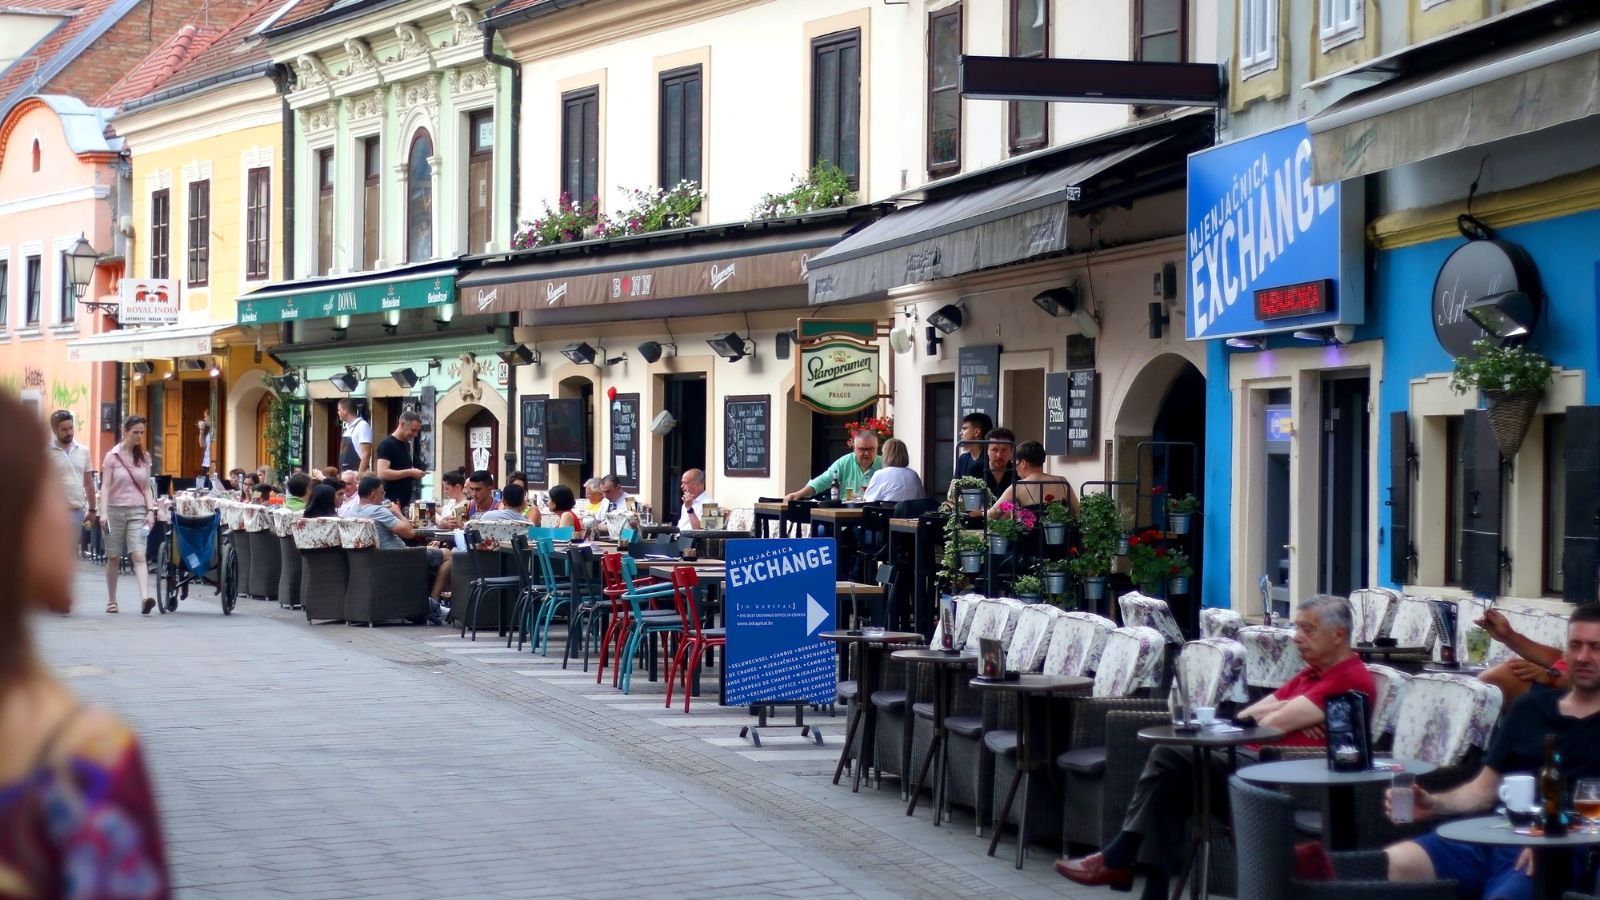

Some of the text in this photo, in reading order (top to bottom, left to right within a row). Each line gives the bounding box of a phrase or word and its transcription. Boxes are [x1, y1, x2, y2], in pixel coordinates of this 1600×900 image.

[1190, 152, 1268, 258] MJENJAČNICA
[808, 356, 872, 385] Staropramen
[730, 546, 832, 587] EXCHANGE
[731, 546, 793, 565] MJENJAČNICA
[737, 667, 757, 676] CHANGE
[803, 649, 829, 659] EXCHANGE
[774, 650, 793, 659] CAMBIO
[801, 672, 836, 684] GELDWECHSE
